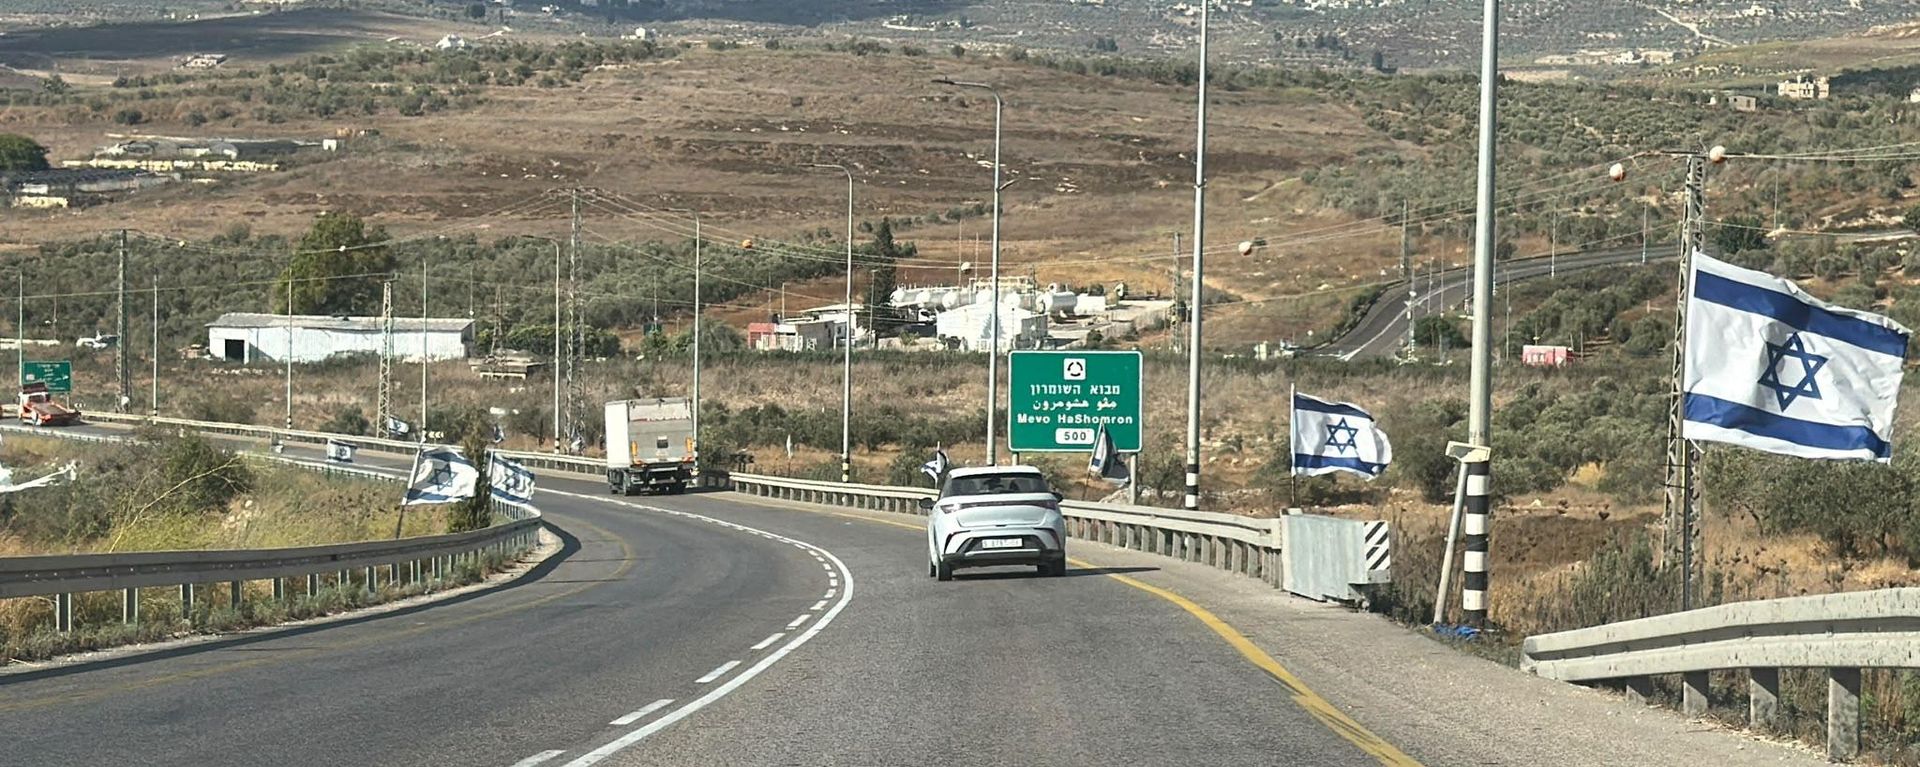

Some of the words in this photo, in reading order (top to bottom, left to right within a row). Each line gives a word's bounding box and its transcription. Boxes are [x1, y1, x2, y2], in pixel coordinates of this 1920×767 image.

[1030, 384, 1081, 395] השומרון
[1090, 384, 1120, 395] מבוא
[1017, 413, 1050, 424] Mevo
[1057, 413, 1133, 424] HaShomron
[1064, 431, 1087, 441] 500
